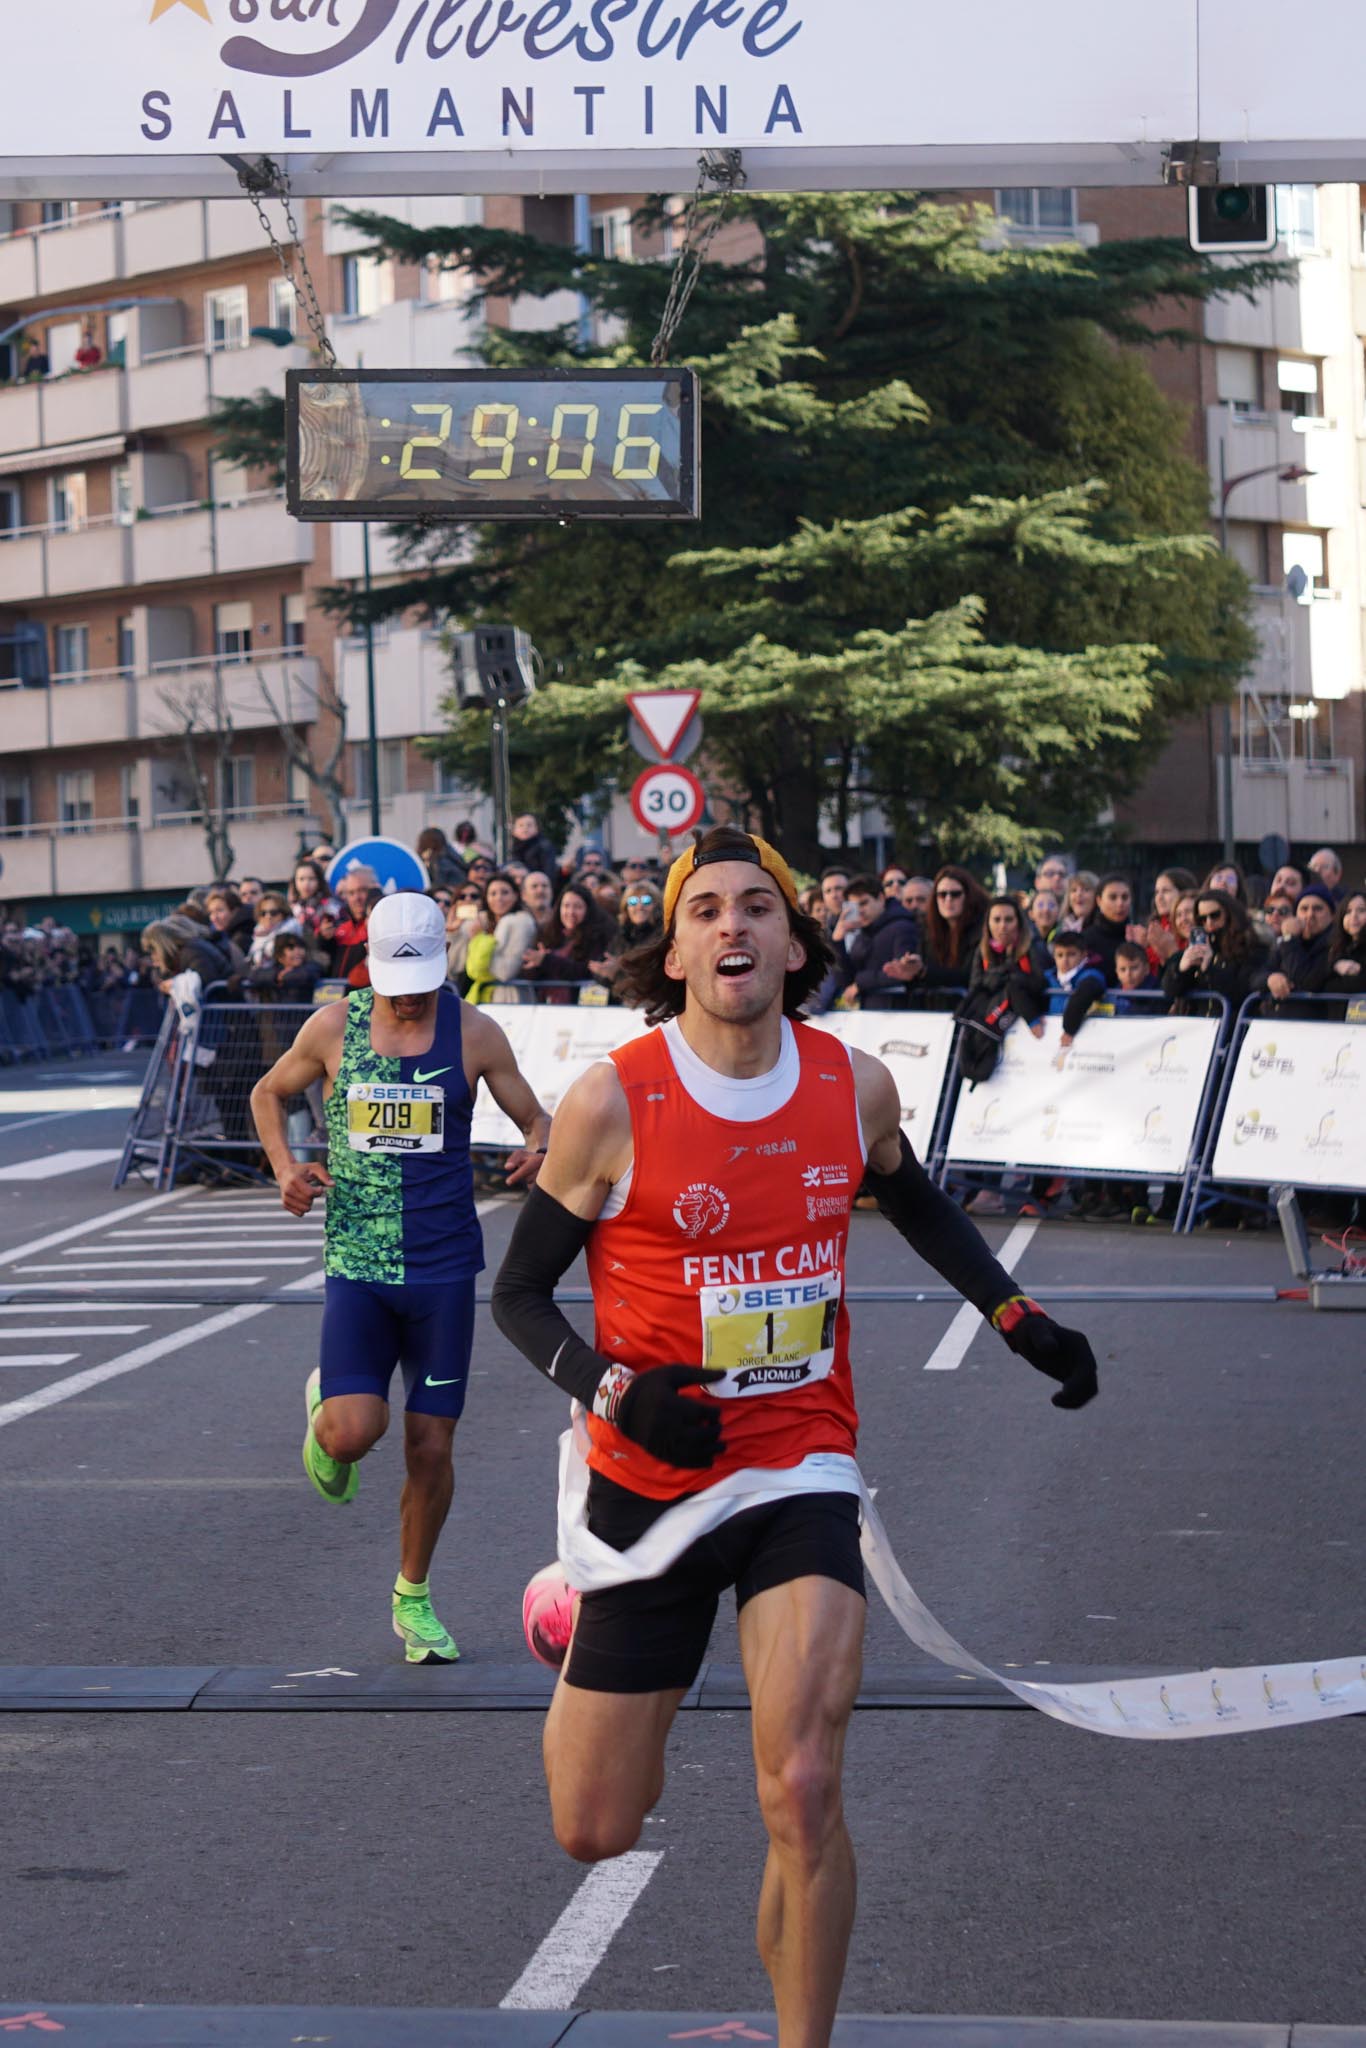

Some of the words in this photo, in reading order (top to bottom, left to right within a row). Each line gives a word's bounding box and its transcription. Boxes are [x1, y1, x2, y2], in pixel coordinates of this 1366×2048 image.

[140, 84, 803, 141] SALMANTINA
[648, 790, 687, 812] 30
[373, 1088, 434, 1099] SETEL
[367, 1102, 412, 1129] 209
[374, 1135, 415, 1149] ALJOMAR
[688, 1183, 707, 1193] FENT
[683, 1250, 766, 1286] FENT
[775, 1232, 843, 1277] CAMÍ
[744, 1282, 830, 1309] SETEL
[764, 1312, 774, 1355] 1
[737, 1356, 767, 1367] JORGE
[749, 1368, 801, 1384] ALJOMAR
